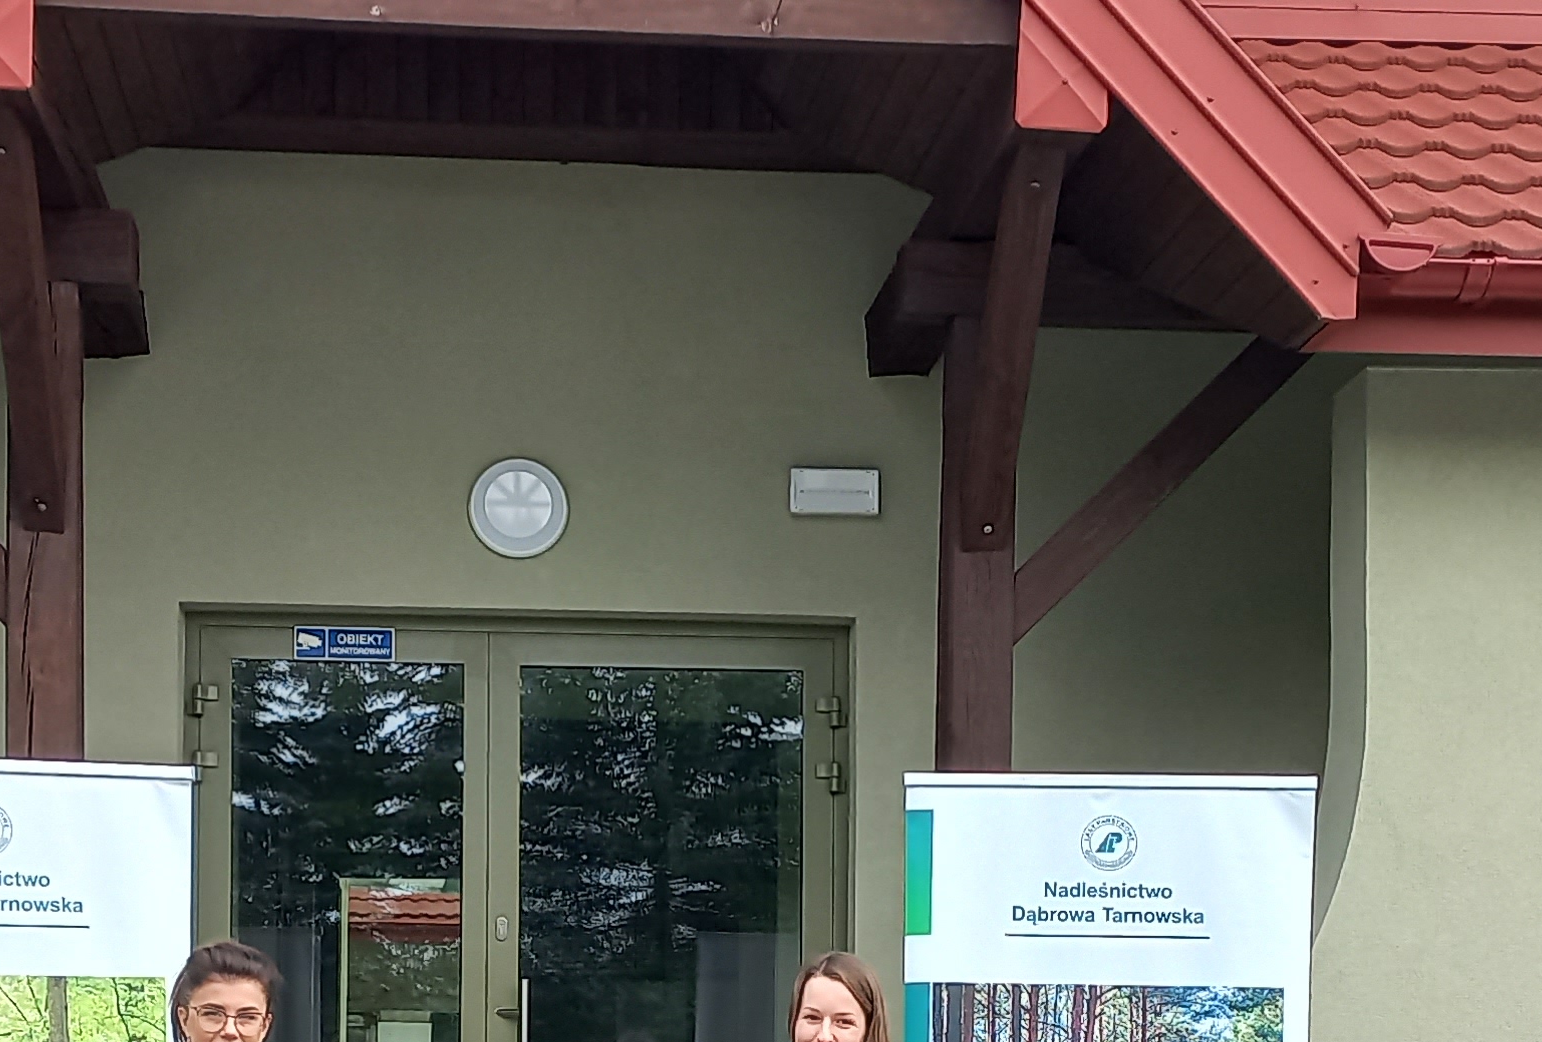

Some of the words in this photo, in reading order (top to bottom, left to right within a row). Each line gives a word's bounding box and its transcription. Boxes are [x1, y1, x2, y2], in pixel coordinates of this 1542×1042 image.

[337, 633, 385, 647] OBIEKT
[1044, 881, 1173, 900] Nadleśnictwo
[1012, 905, 1095, 925] Dąbrowa
[1102, 906, 1204, 925] Tarnowska
